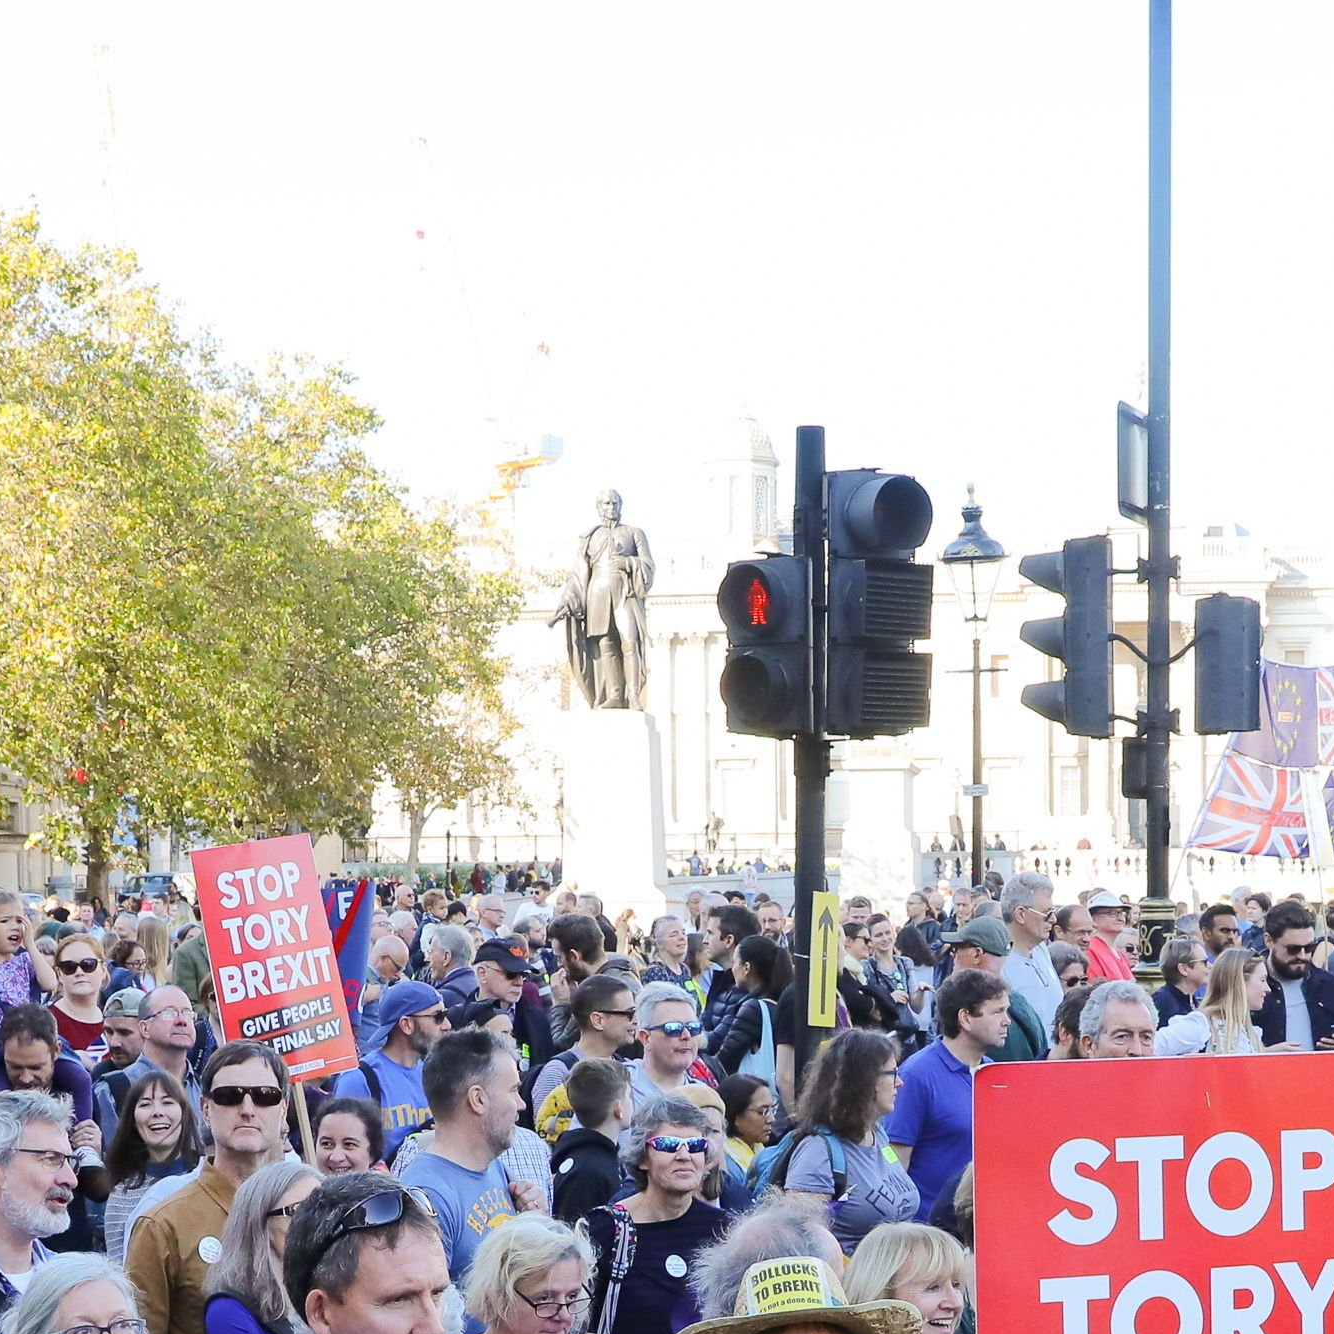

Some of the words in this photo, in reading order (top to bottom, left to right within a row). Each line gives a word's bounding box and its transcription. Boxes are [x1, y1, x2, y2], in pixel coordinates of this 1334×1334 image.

[217, 861, 300, 909] STOP
[221, 904, 310, 955] TORY
[218, 946, 332, 1004] BREXIT
[242, 1009, 280, 1037] GIVE
[283, 996, 332, 1027] PEOPLE
[273, 1026, 315, 1055] FINAL
[317, 1018, 341, 1041] SAY
[750, 1263, 819, 1288] BOLLOCKS
[754, 1287, 769, 1304] TO
[772, 1279, 821, 1295] BREXIT
